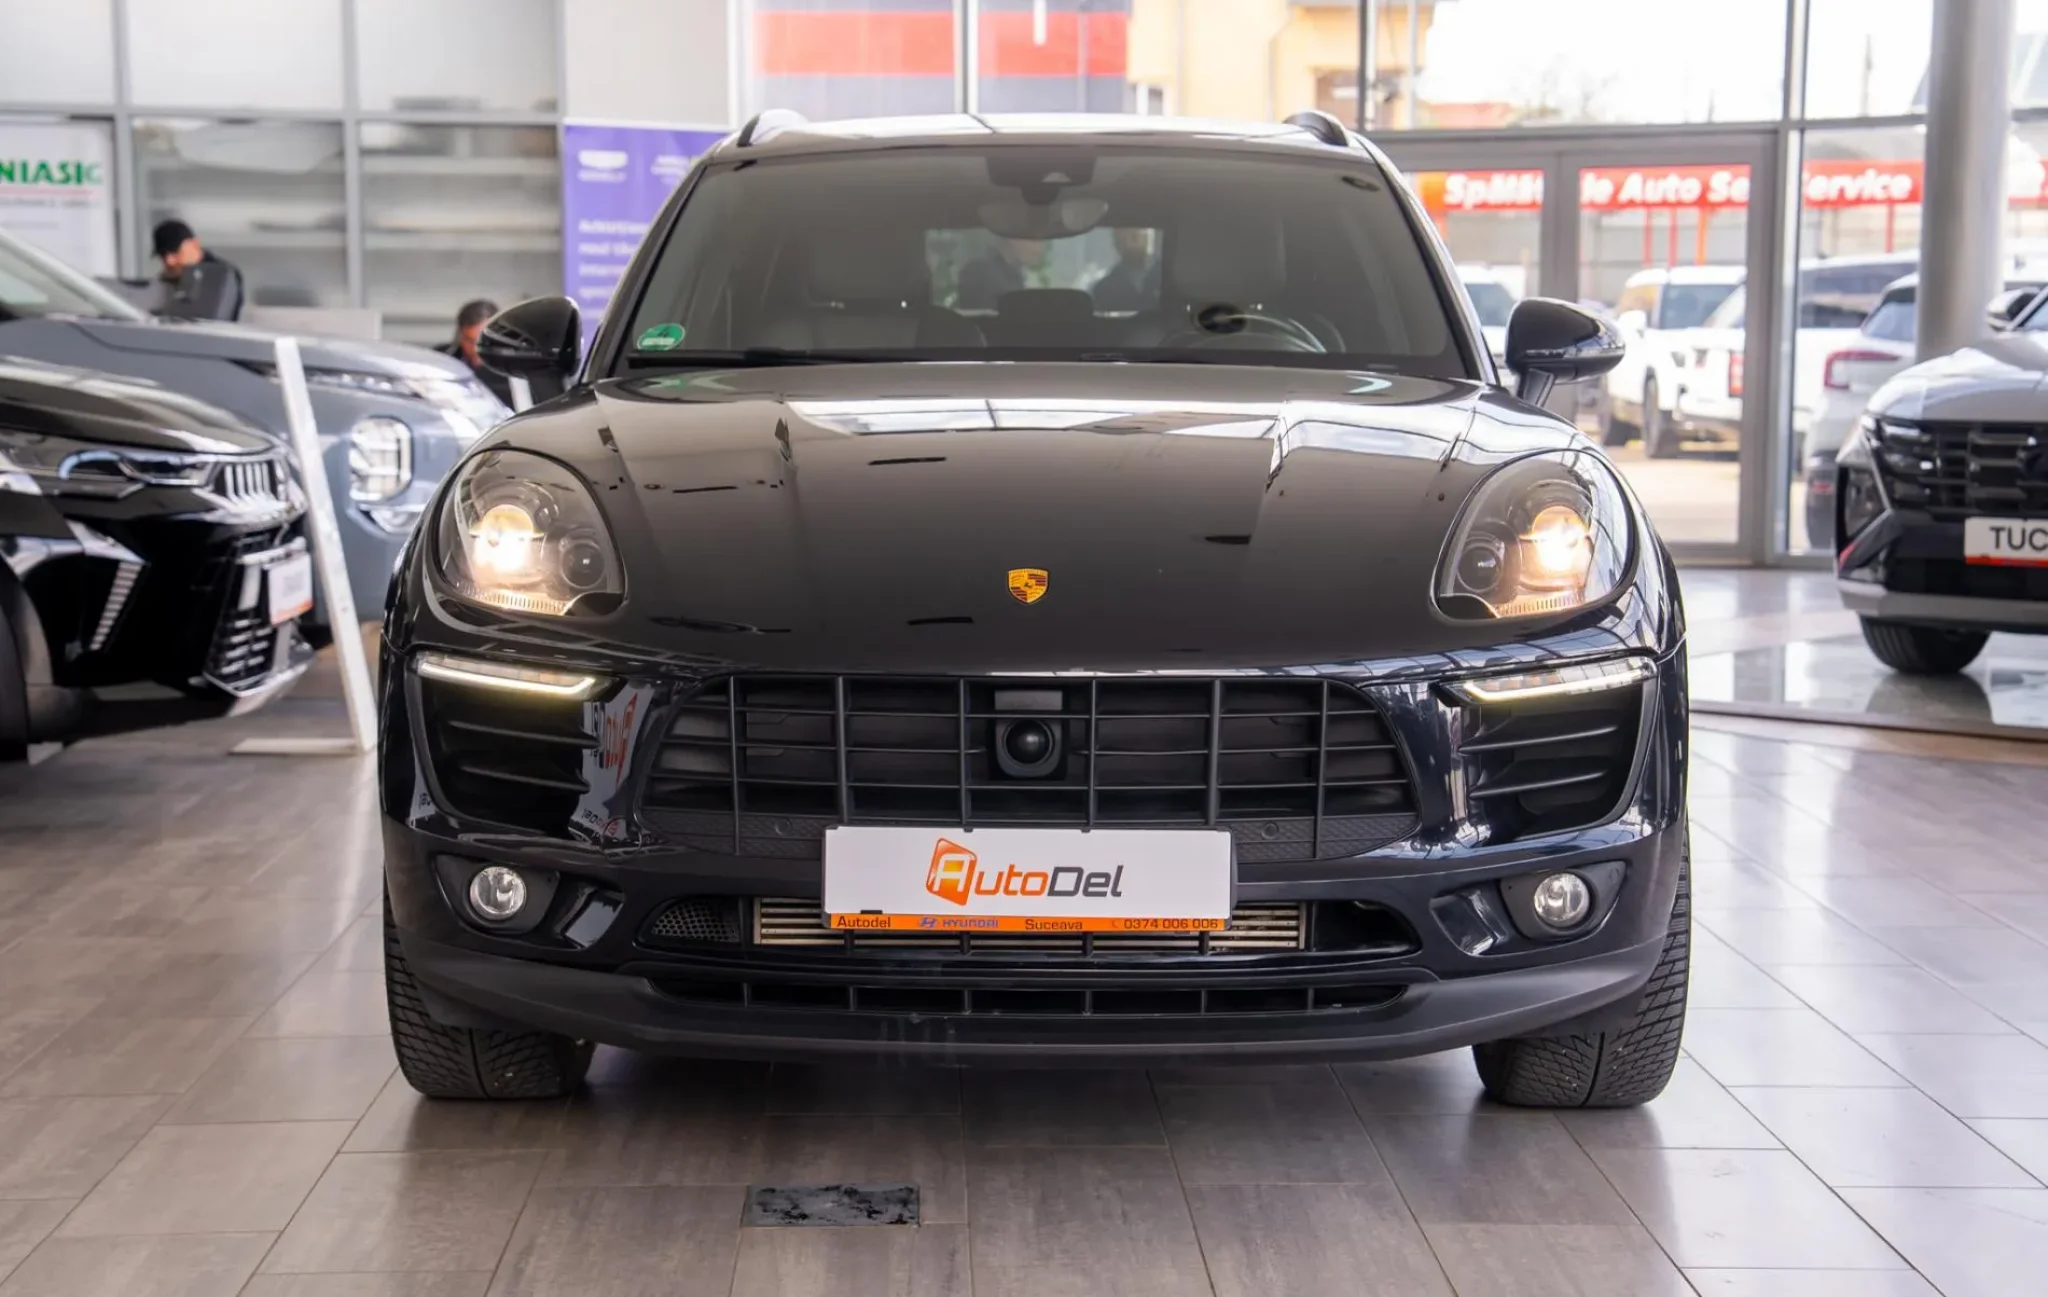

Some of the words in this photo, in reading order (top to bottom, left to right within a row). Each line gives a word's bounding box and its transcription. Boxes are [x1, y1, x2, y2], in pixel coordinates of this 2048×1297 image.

[1618, 172, 1702, 204] Auto
[1803, 168, 1912, 201] ervice
[930, 847, 1124, 899] AutoDel
[836, 916, 891, 929] Autodel
[942, 919, 998, 928] HYUNDAI
[1025, 919, 1083, 931] Suceava
[1124, 919, 1158, 930] 0374
[1162, 919, 1188, 930] 006
[1192, 919, 1218, 930] 006
